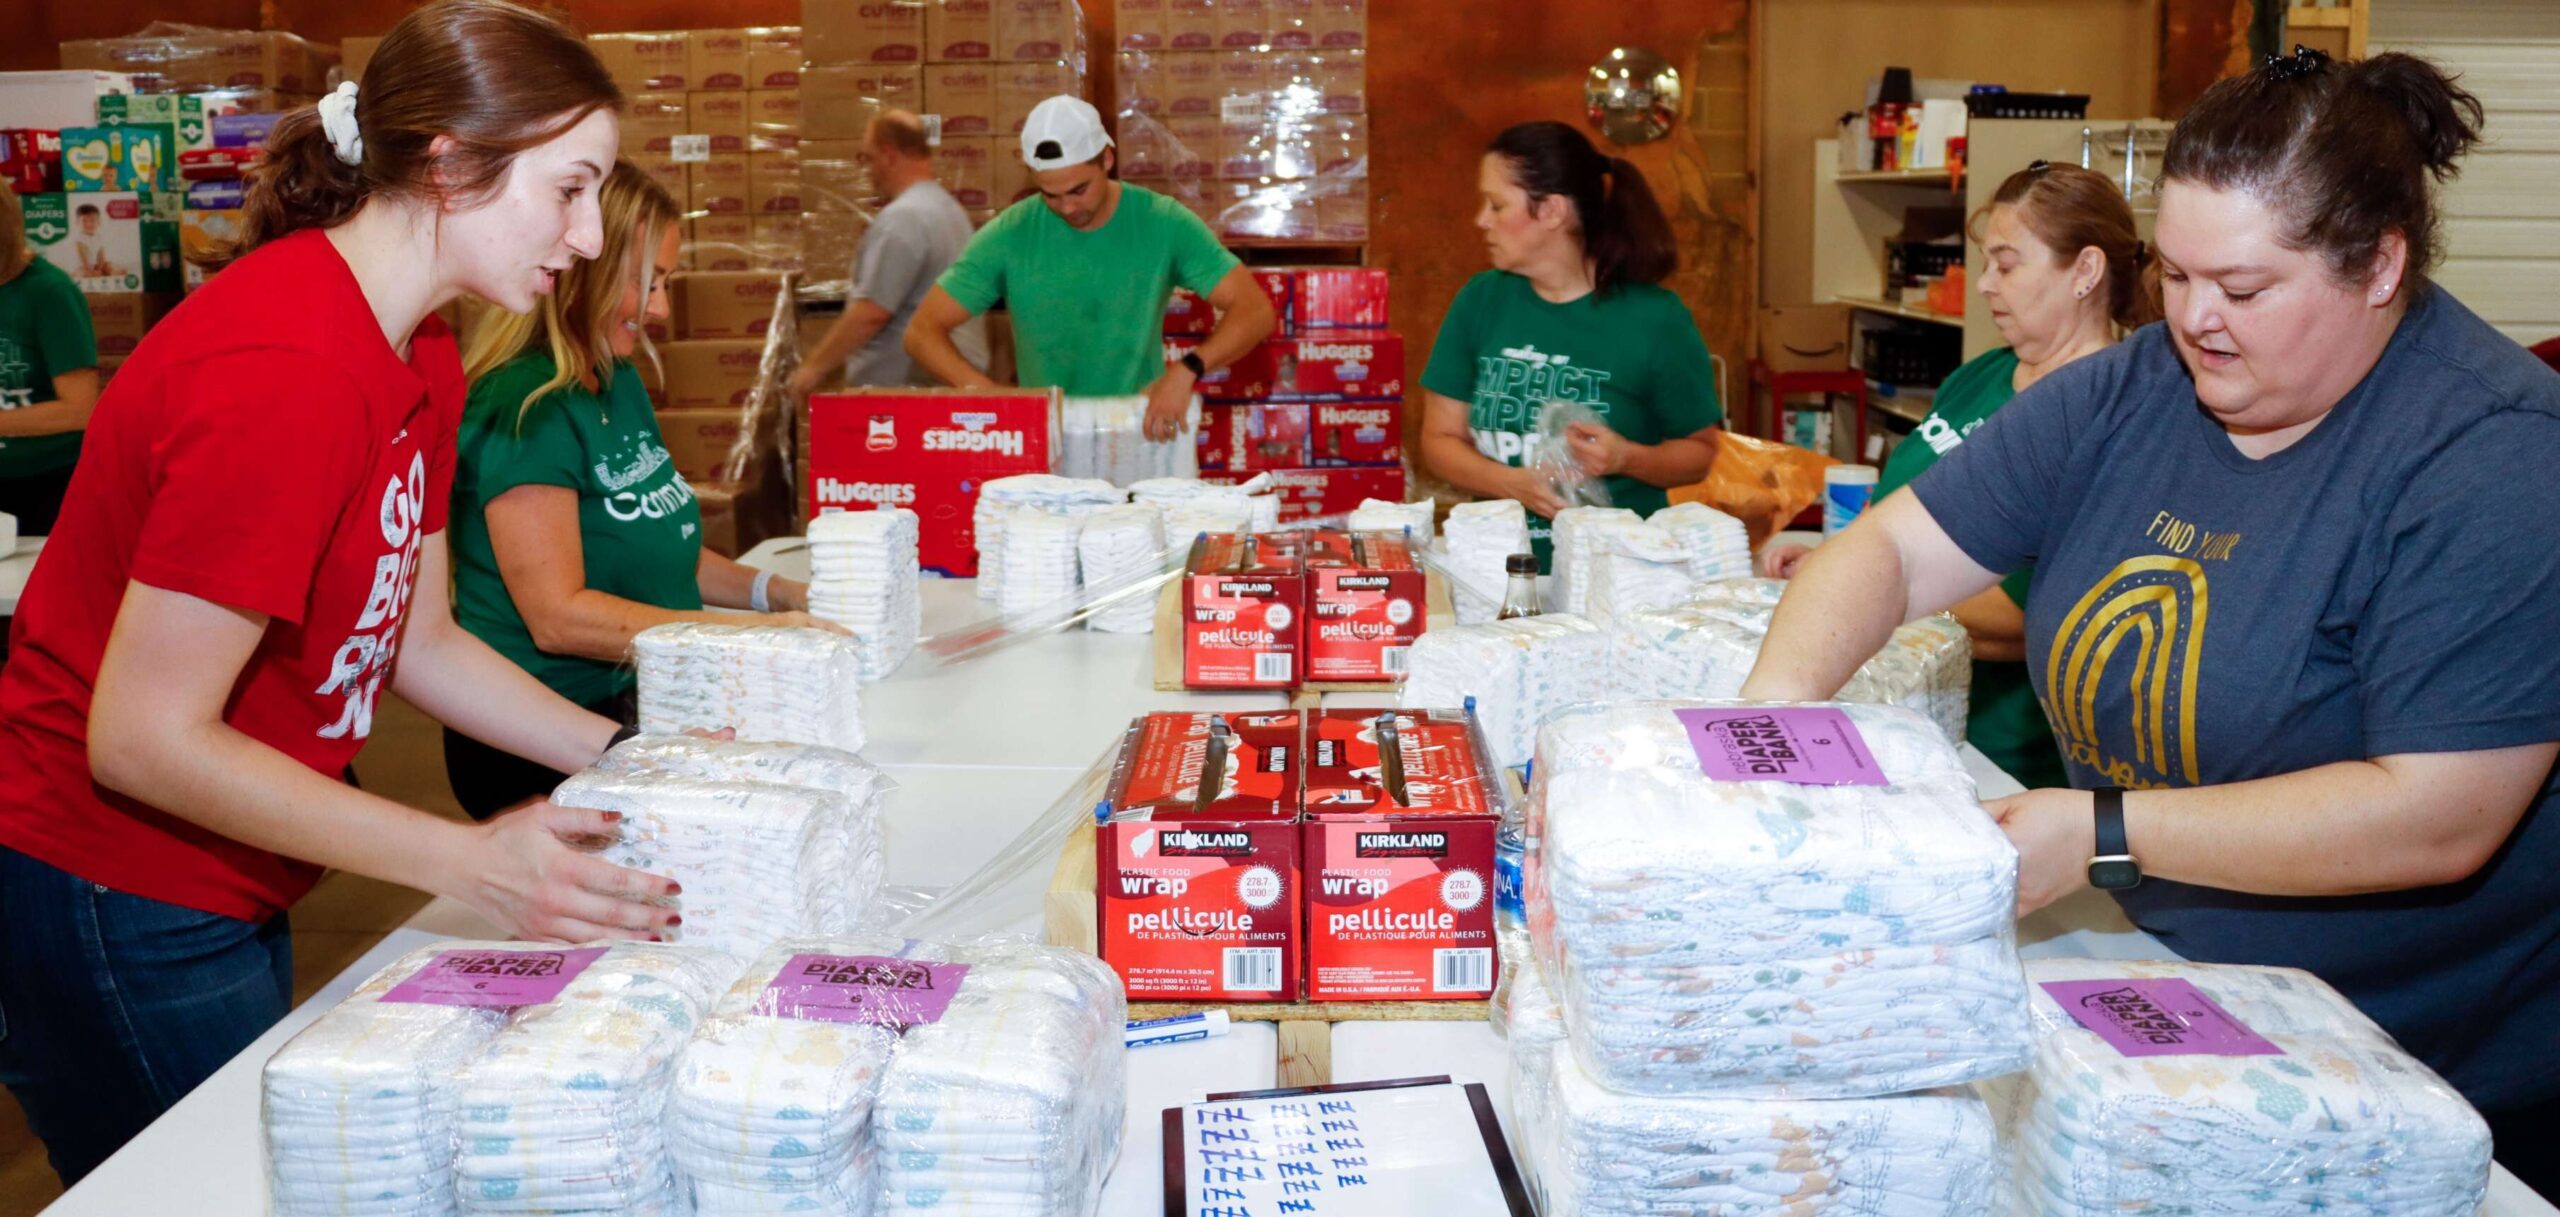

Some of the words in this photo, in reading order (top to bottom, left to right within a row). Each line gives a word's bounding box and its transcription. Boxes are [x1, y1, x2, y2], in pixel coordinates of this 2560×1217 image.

[735, 278, 783, 297] cutie
[1299, 341, 1373, 361] HUGGIES
[1477, 356, 1611, 403] MPACT
[1320, 407, 1390, 424] HUGGIES
[923, 429, 1024, 456] HUGGIES
[816, 478, 916, 503] HUGGIES
[2145, 510, 2195, 553] FIND
[2192, 530, 2241, 561] YOUR
[1221, 583, 1273, 592] KIRKLAND
[1339, 577, 1390, 586] KIRKLAND
[1195, 609, 1237, 623] wrap
[1316, 602, 1357, 617] wrap
[1199, 627, 1275, 645] pellicule
[1320, 621, 1395, 639] pellicule
[1755, 717, 1797, 759] BANK
[1318, 740, 1334, 766] KIRKLAND
[1714, 726, 1747, 774] nebraska
[1727, 720, 1778, 774] DIAPER
[1163, 833, 1249, 847] KIKLAND
[1360, 834, 1445, 848] KIRKLAND
[1120, 867, 1159, 876] PLASTIC
[1162, 868, 1191, 876] FOOD
[1322, 868, 1361, 877] PLASTIC
[1364, 868, 1392, 876] FOOD
[1121, 877, 1188, 899] wrap
[1246, 877, 1269, 887] 278.7
[1322, 877, 1389, 899] wrap
[1449, 880, 1472, 890] 278.7
[1246, 888, 1267, 897] 3000
[1449, 891, 1470, 900] 3000
[1127, 907, 1254, 934] pellicule
[1329, 907, 1454, 935] pellicule
[1137, 931, 1151, 940] DE
[1153, 930, 1206, 941] PLASTIQUE
[1208, 931, 1236, 941] POUR
[1238, 931, 1287, 940] ALIMENTS
[1337, 932, 1351, 940] DE
[1353, 931, 1407, 941] PLASTIQUE
[1408, 931, 1437, 940] POUR
[1439, 930, 1487, 940] ALIMENTS
[448, 957, 557, 969] DIAPER
[463, 965, 550, 977] BANK
[474, 982, 489, 990] 6
[829, 974, 917, 989] BANK
[850, 994, 862, 1003] 6
[2099, 995, 2176, 1045] DIAPER
[2124, 991, 2184, 1033] BANK
